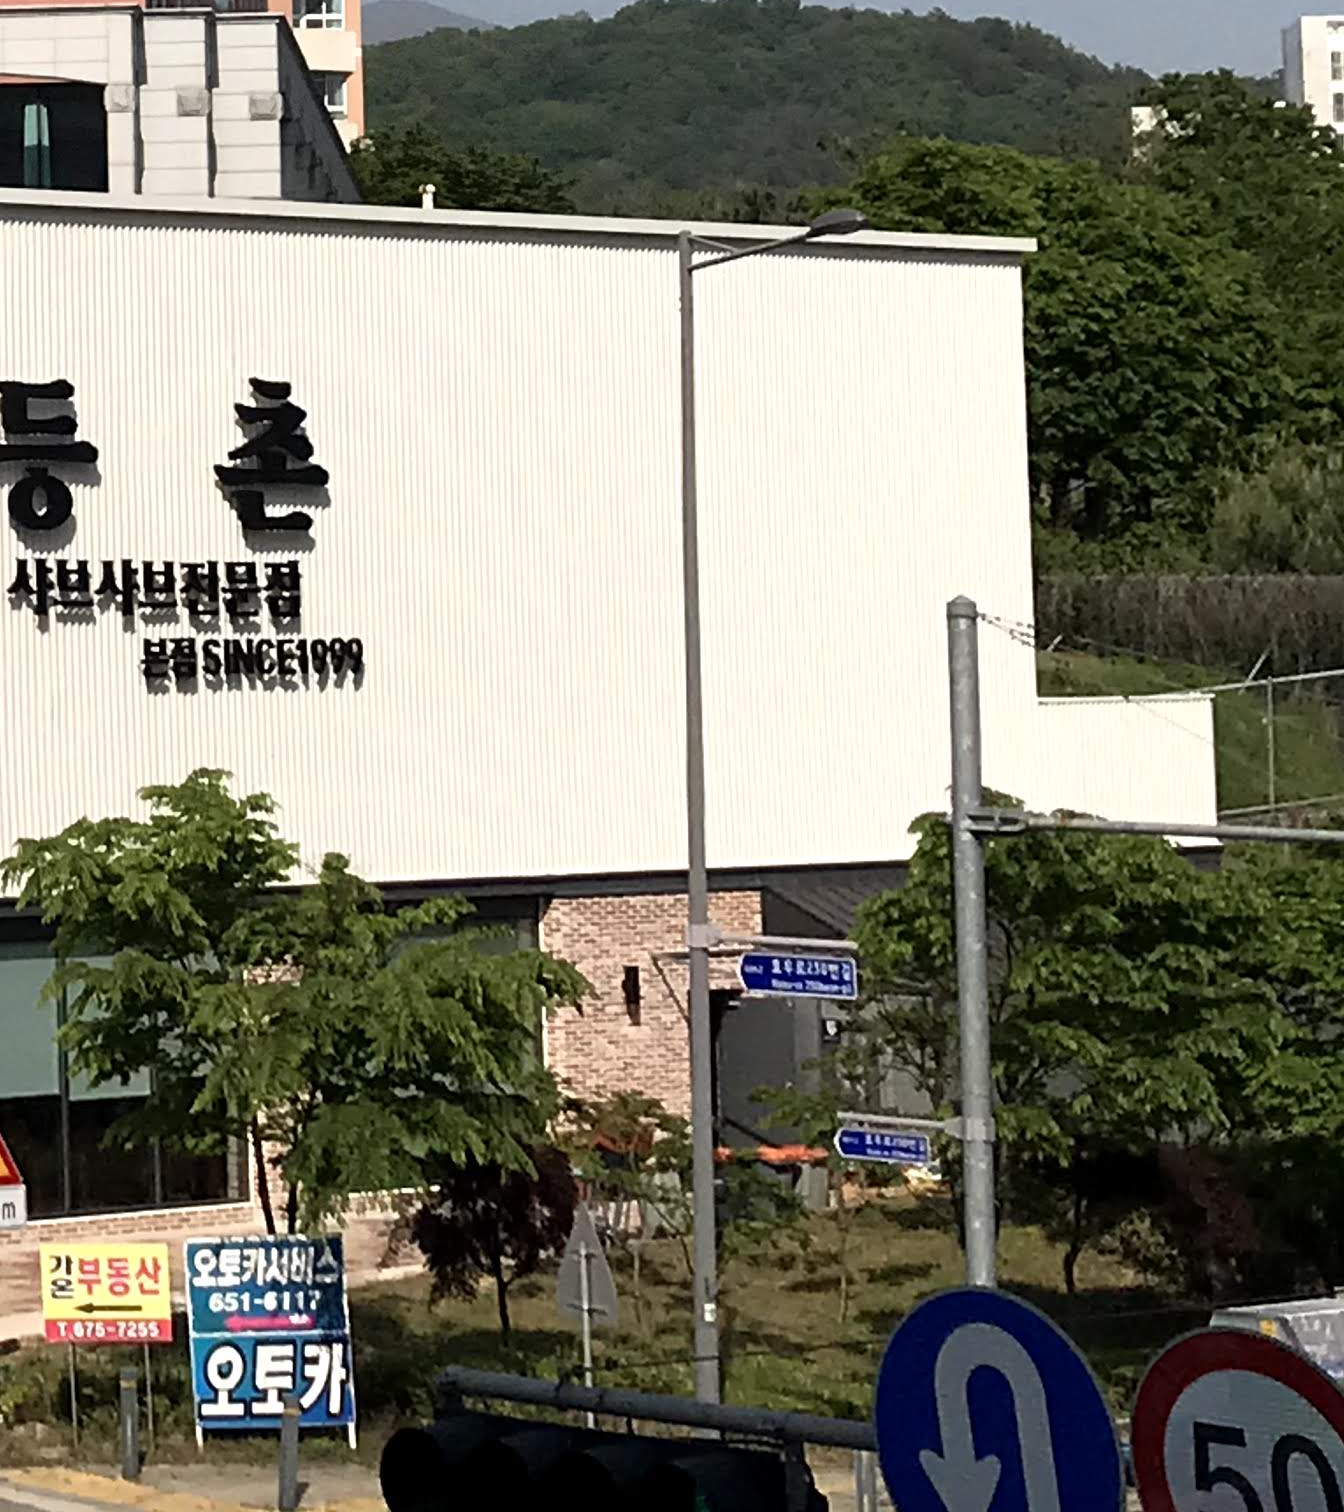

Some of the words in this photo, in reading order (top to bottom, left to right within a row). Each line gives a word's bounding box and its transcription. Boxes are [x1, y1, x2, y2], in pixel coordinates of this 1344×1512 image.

[8, 558, 301, 616] 샤브샤브전문점
[78, 1255, 162, 1296] 부동산
[192, 1245, 339, 1287] 오토카서비스
[200, 1342, 347, 1416] 오토카
